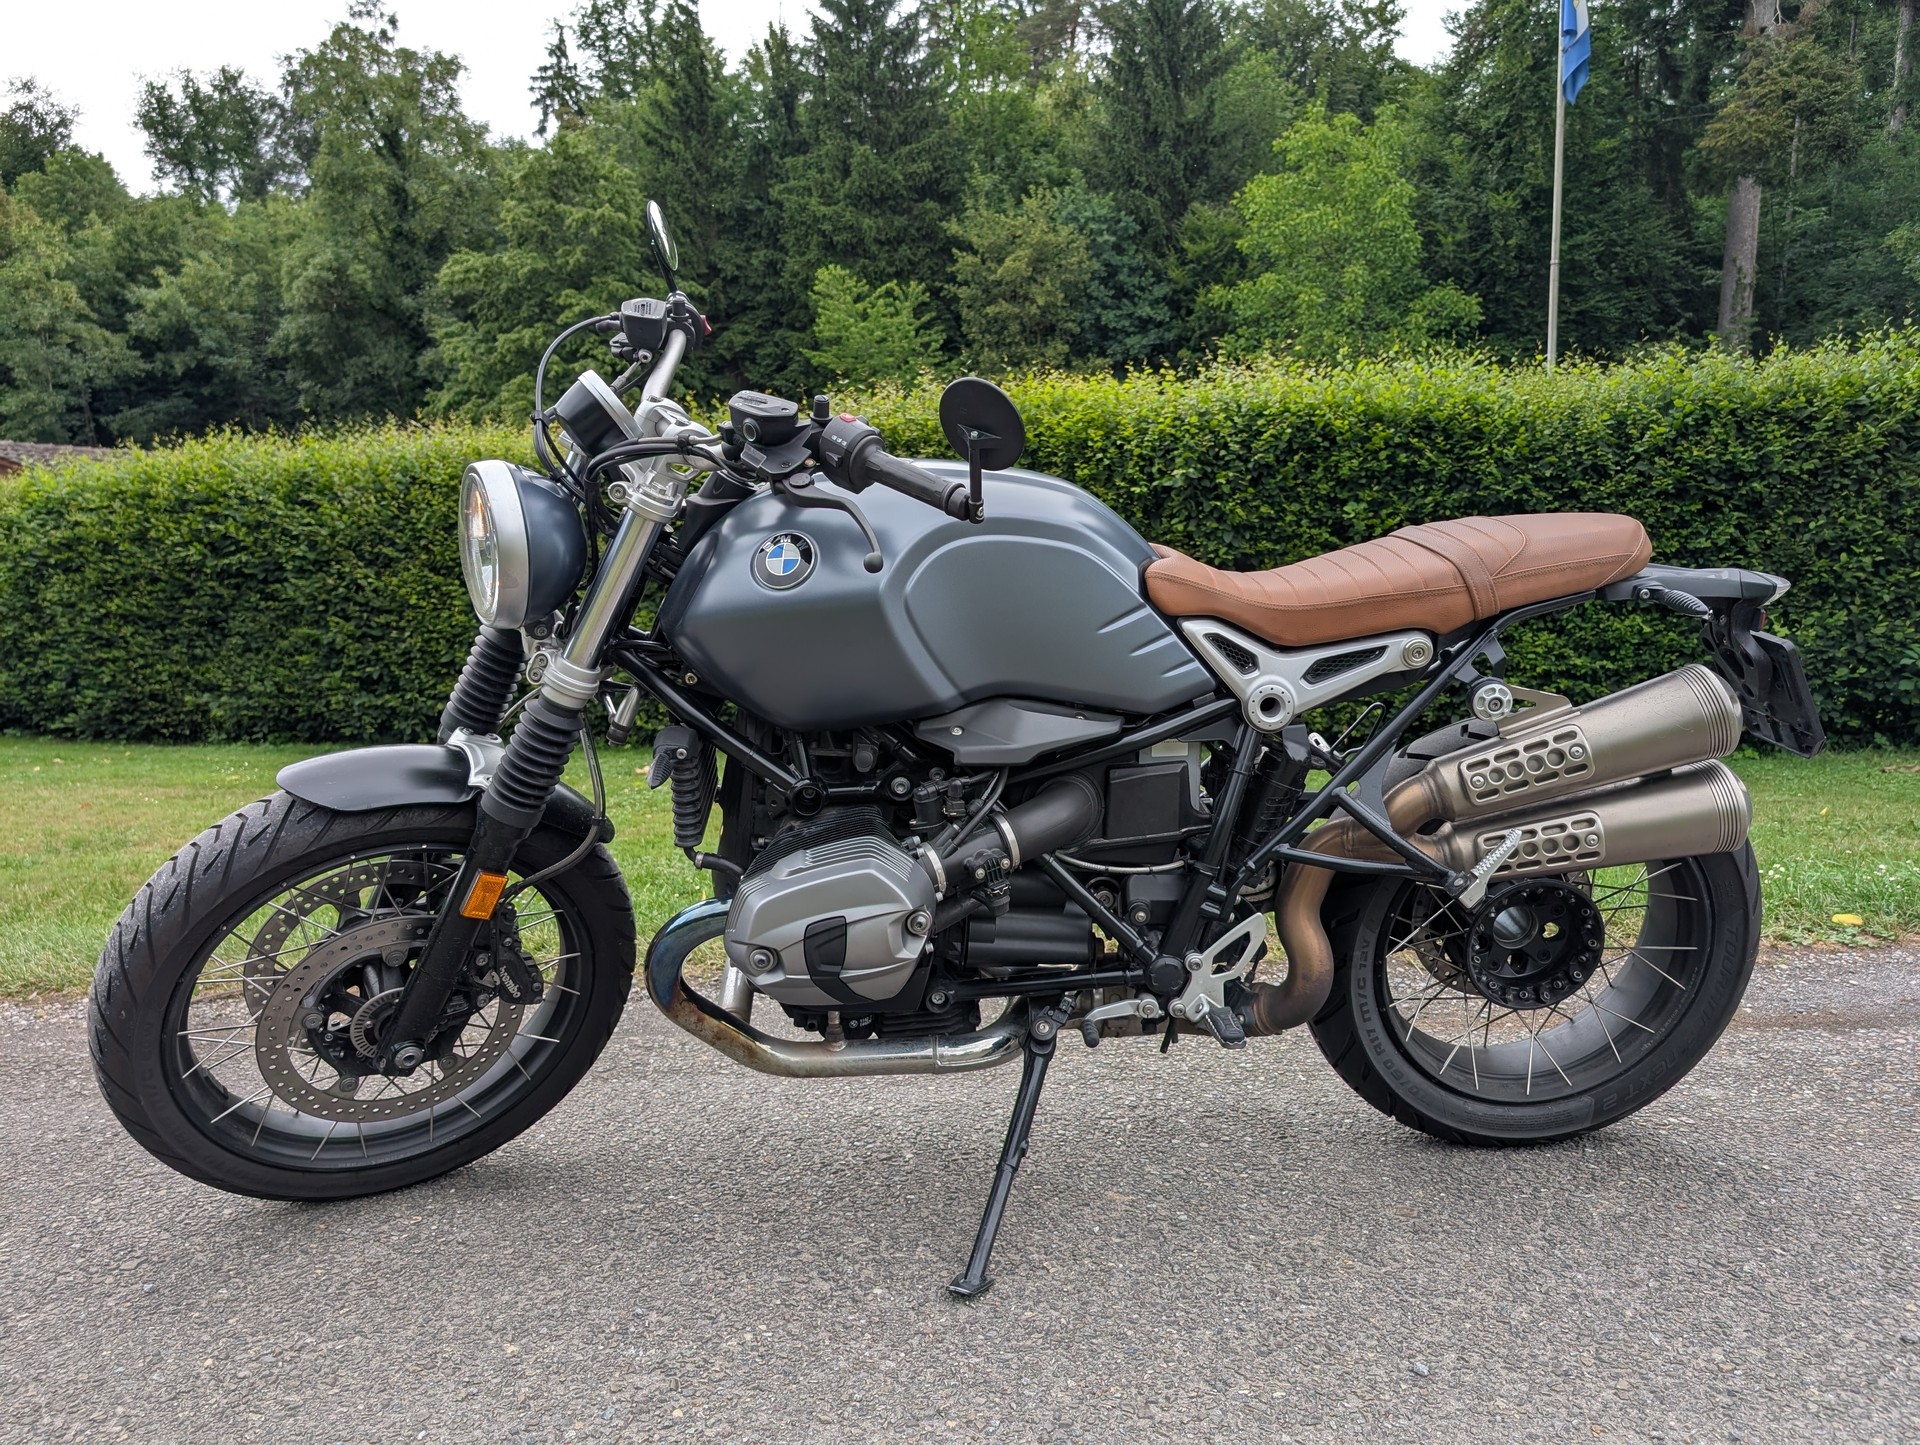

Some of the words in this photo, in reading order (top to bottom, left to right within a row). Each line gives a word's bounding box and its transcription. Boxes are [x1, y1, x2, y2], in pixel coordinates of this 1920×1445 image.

[763, 535, 809, 552] BMW
[499, 965, 522, 998] brembo
[1365, 1028, 1386, 1057] R17
[1602, 1092, 1618, 1111] 2
